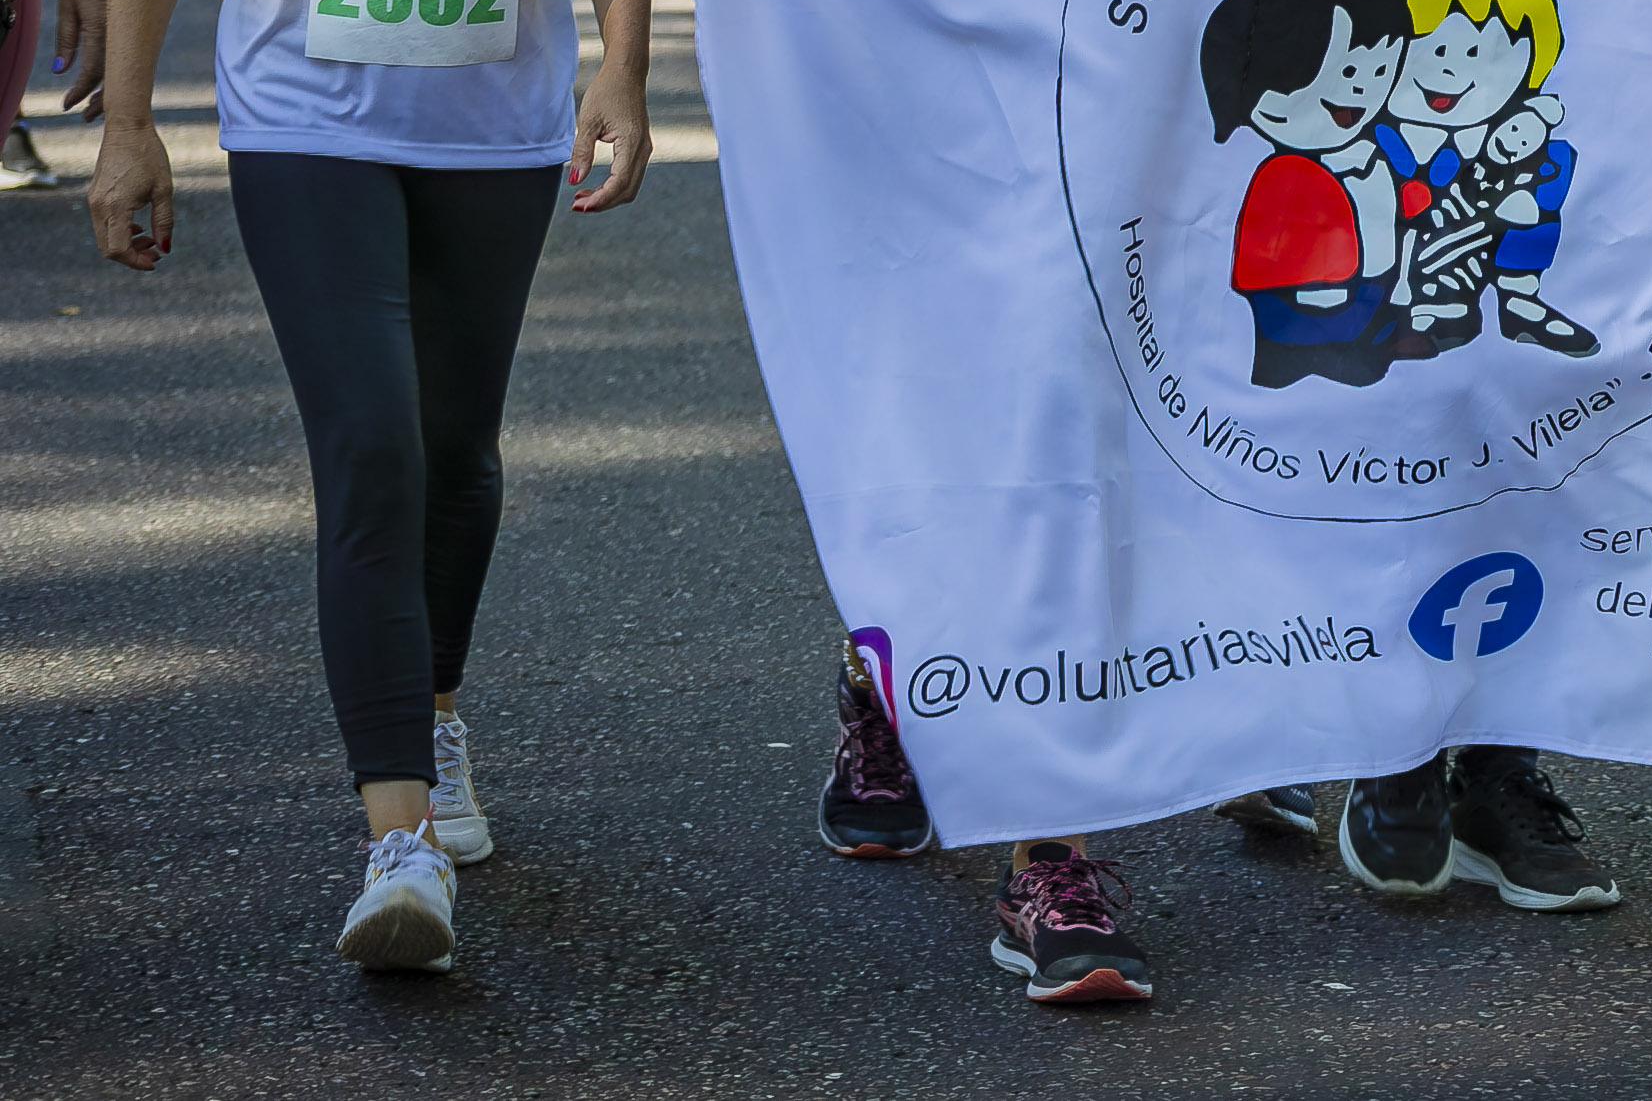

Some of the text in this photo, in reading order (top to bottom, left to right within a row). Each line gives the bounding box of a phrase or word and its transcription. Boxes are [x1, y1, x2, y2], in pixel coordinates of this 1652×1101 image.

[1120, 217, 1165, 373] Hospital
[1158, 374, 1186, 418] de
[1187, 406, 1300, 479] Niños
[1318, 447, 1450, 484] Víctor
[1472, 442, 1503, 468] J.
